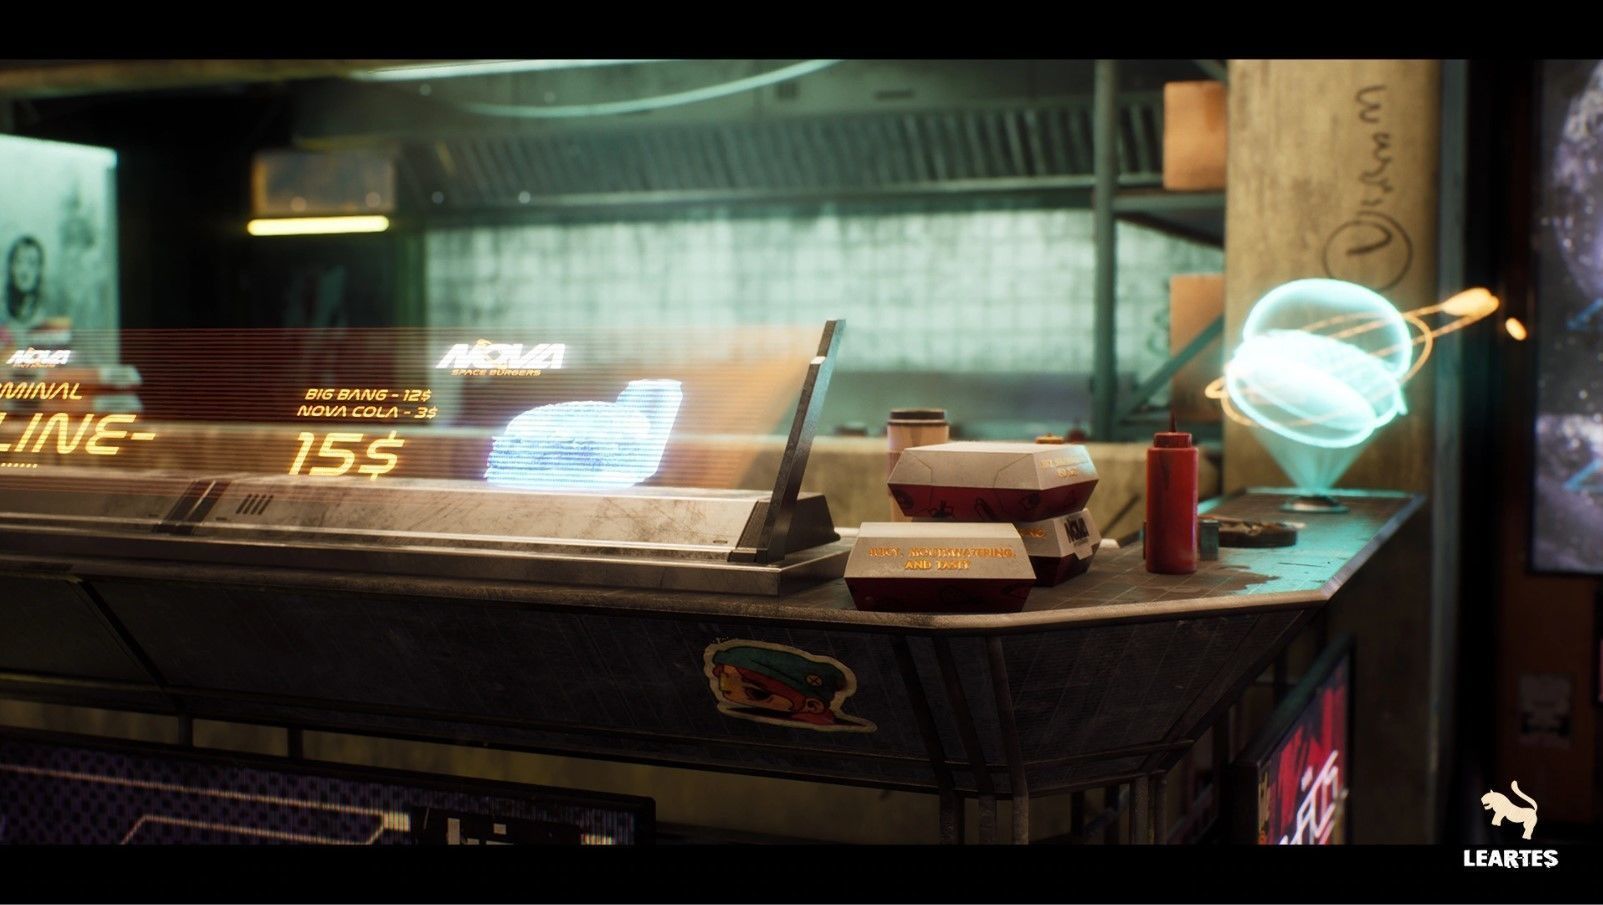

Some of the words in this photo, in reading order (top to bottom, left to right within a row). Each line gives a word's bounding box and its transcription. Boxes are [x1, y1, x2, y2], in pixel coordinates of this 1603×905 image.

[435, 342, 565, 369] NOVA
[451, 368, 487, 376] SPACE
[489, 369, 541, 377] BURGERS
[0, 382, 82, 400] MINAL
[305, 388, 335, 401] BIG
[337, 388, 388, 402] BANG
[402, 389, 432, 402] 12$
[297, 405, 347, 418] NOVA
[351, 406, 398, 418] COLA
[414, 406, 438, 419] 3$
[288, 430, 405, 481] 15$
[904, 559, 932, 571] AND
[935, 560, 971, 571] TASTY
